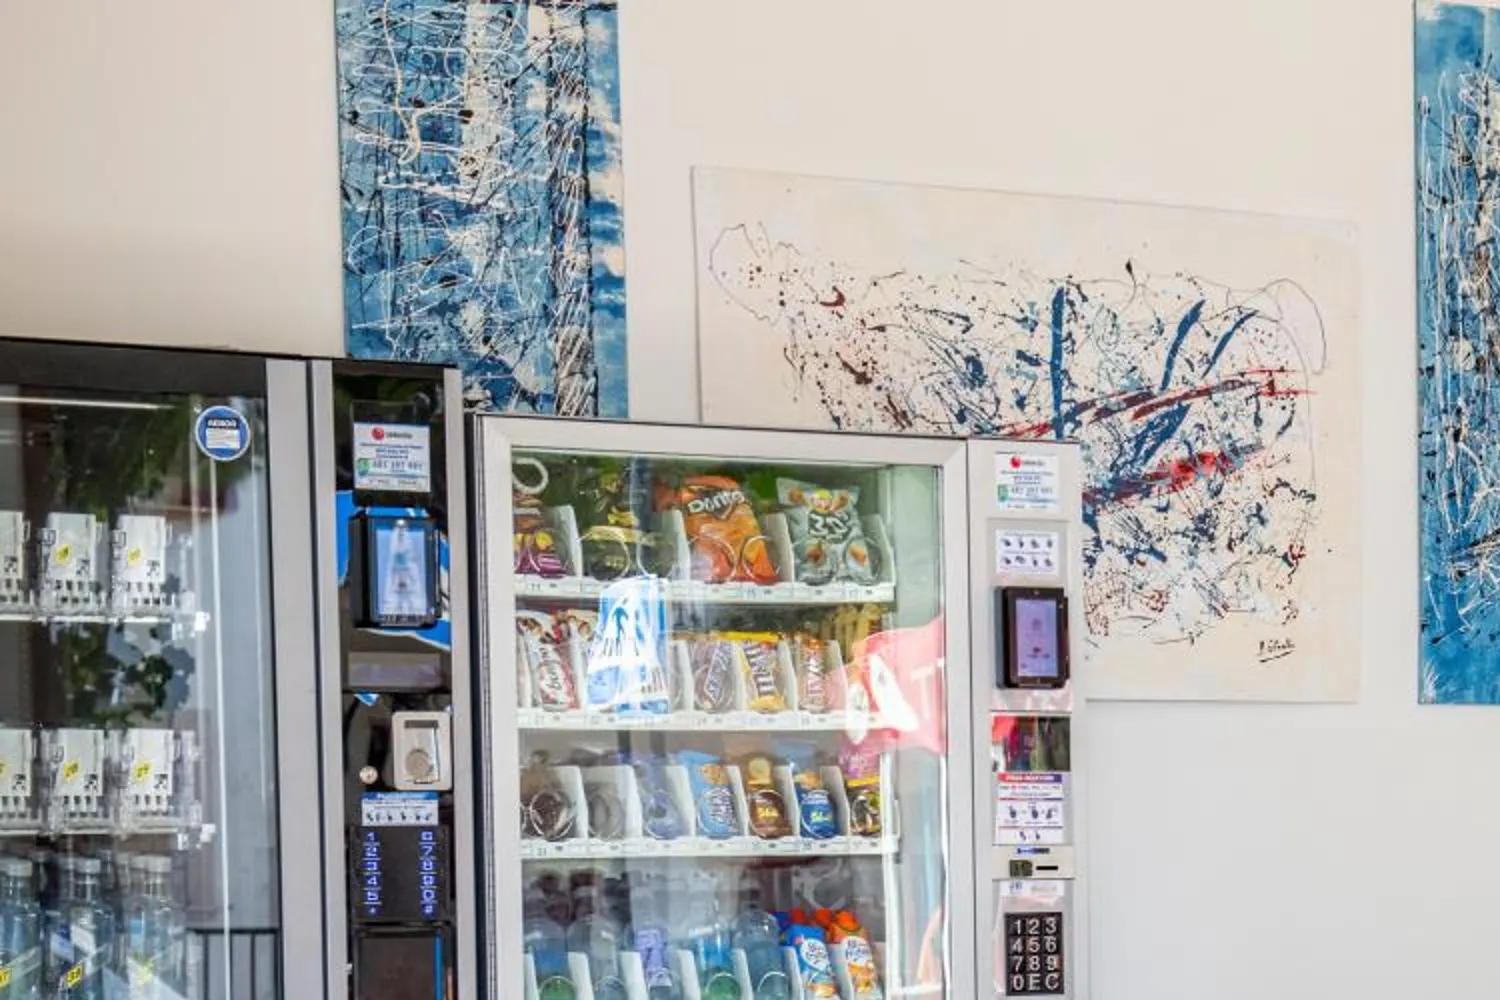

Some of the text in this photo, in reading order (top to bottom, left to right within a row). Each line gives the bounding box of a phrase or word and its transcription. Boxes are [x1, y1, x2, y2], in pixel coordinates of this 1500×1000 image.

[1013, 917, 1057, 935] 1 2 3
[1012, 935, 1057, 953] 4 5 6
[1013, 955, 1057, 972] 7 8 9
[1013, 973, 1060, 991] 0 E C
